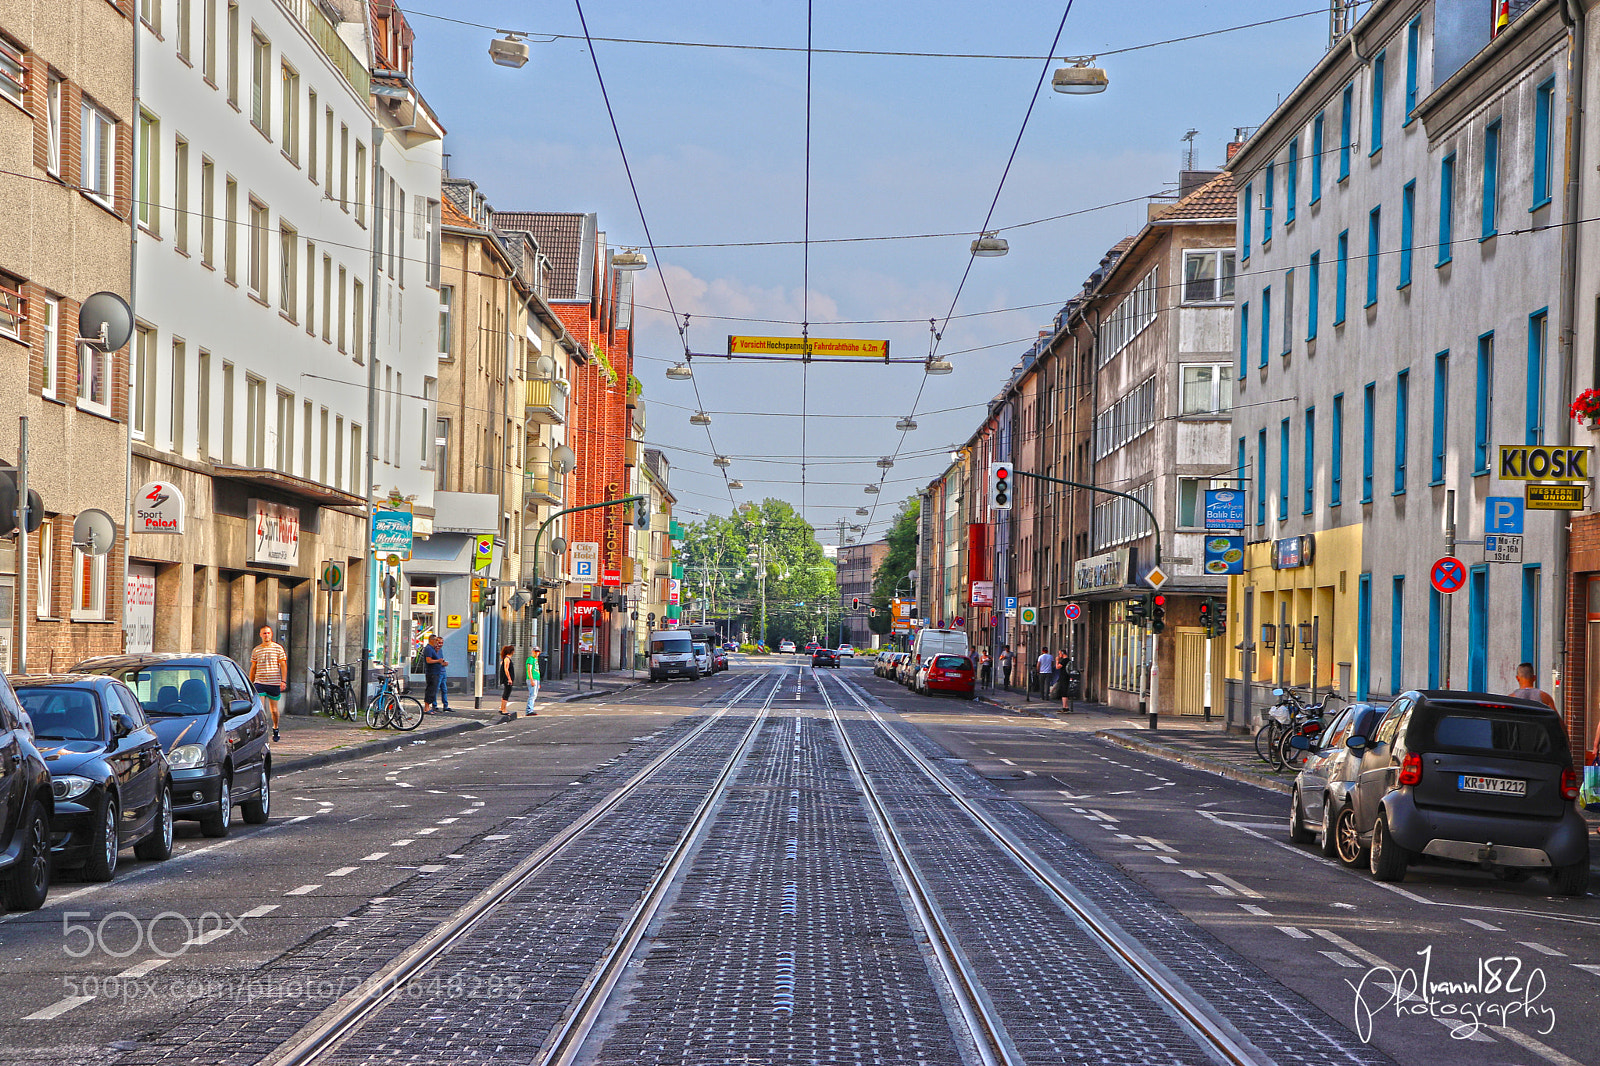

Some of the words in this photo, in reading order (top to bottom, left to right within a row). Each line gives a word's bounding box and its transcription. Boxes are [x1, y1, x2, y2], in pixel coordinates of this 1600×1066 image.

[740, 340, 766, 349] Vorsicht
[766, 341, 813, 351] Hochspannung
[813, 342, 859, 352] Fahrdrahthöhe
[1501, 448, 1585, 478] KIOSK
[137, 510, 163, 520] Sport
[1230, 510, 1243, 518] Evi
[1493, 501, 1515, 529] P
[145, 518, 177, 528] Palast
[576, 543, 593, 552] City
[606, 529, 618, 570] HOTE
[1464, 776, 1478, 789] KR
[1484, 779, 1498, 791] YY
[1500, 781, 1525, 793] 1212
